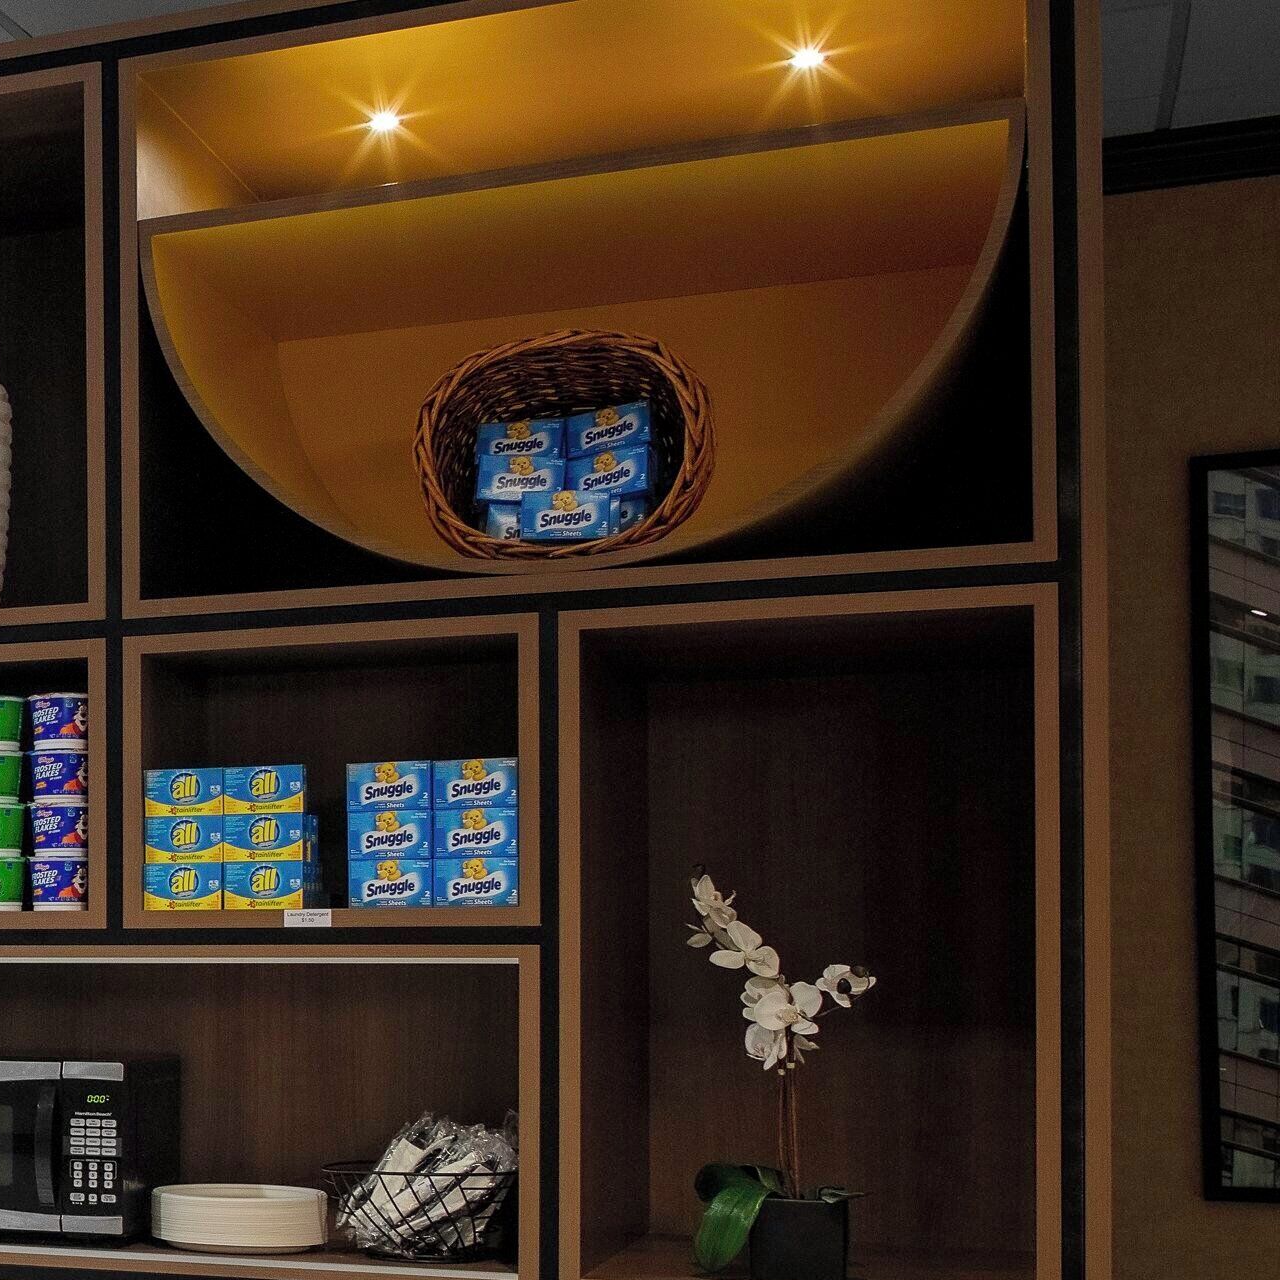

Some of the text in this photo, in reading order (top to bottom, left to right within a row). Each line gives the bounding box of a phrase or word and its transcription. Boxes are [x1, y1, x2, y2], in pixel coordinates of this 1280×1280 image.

[585, 420, 634, 445] Snuggle
[494, 438, 544, 455] Snuggle
[496, 475, 547, 490] Snuggle
[582, 467, 631, 491] Snuggle
[540, 509, 592, 528] Snuggle
[32, 707, 59, 718] FROSTED
[34, 763, 63, 774] FROSTED
[172, 775, 198, 799] all
[251, 771, 278, 796] all
[364, 781, 413, 801] Snuggle
[451, 778, 501, 798] Snuggle
[171, 806, 204, 815] tainlifter
[248, 803, 283, 812] tainlifter
[33, 816, 61, 827] FROSTED
[172, 822, 198, 847] all
[251, 819, 277, 845] all
[365, 829, 414, 849] Snuggle
[451, 827, 501, 847] Snuggle
[171, 853, 204, 862] tainlifter
[248, 850, 283, 860] tainlifter
[386, 850, 405, 858] Sheets
[32, 870, 58, 881] FROSTED
[171, 869, 196, 894] all
[251, 867, 277, 893] all
[367, 878, 415, 898] Snuggle
[451, 877, 502, 897] Snuggle
[169, 900, 203, 909] tainlifter
[248, 899, 283, 909] tainlifter
